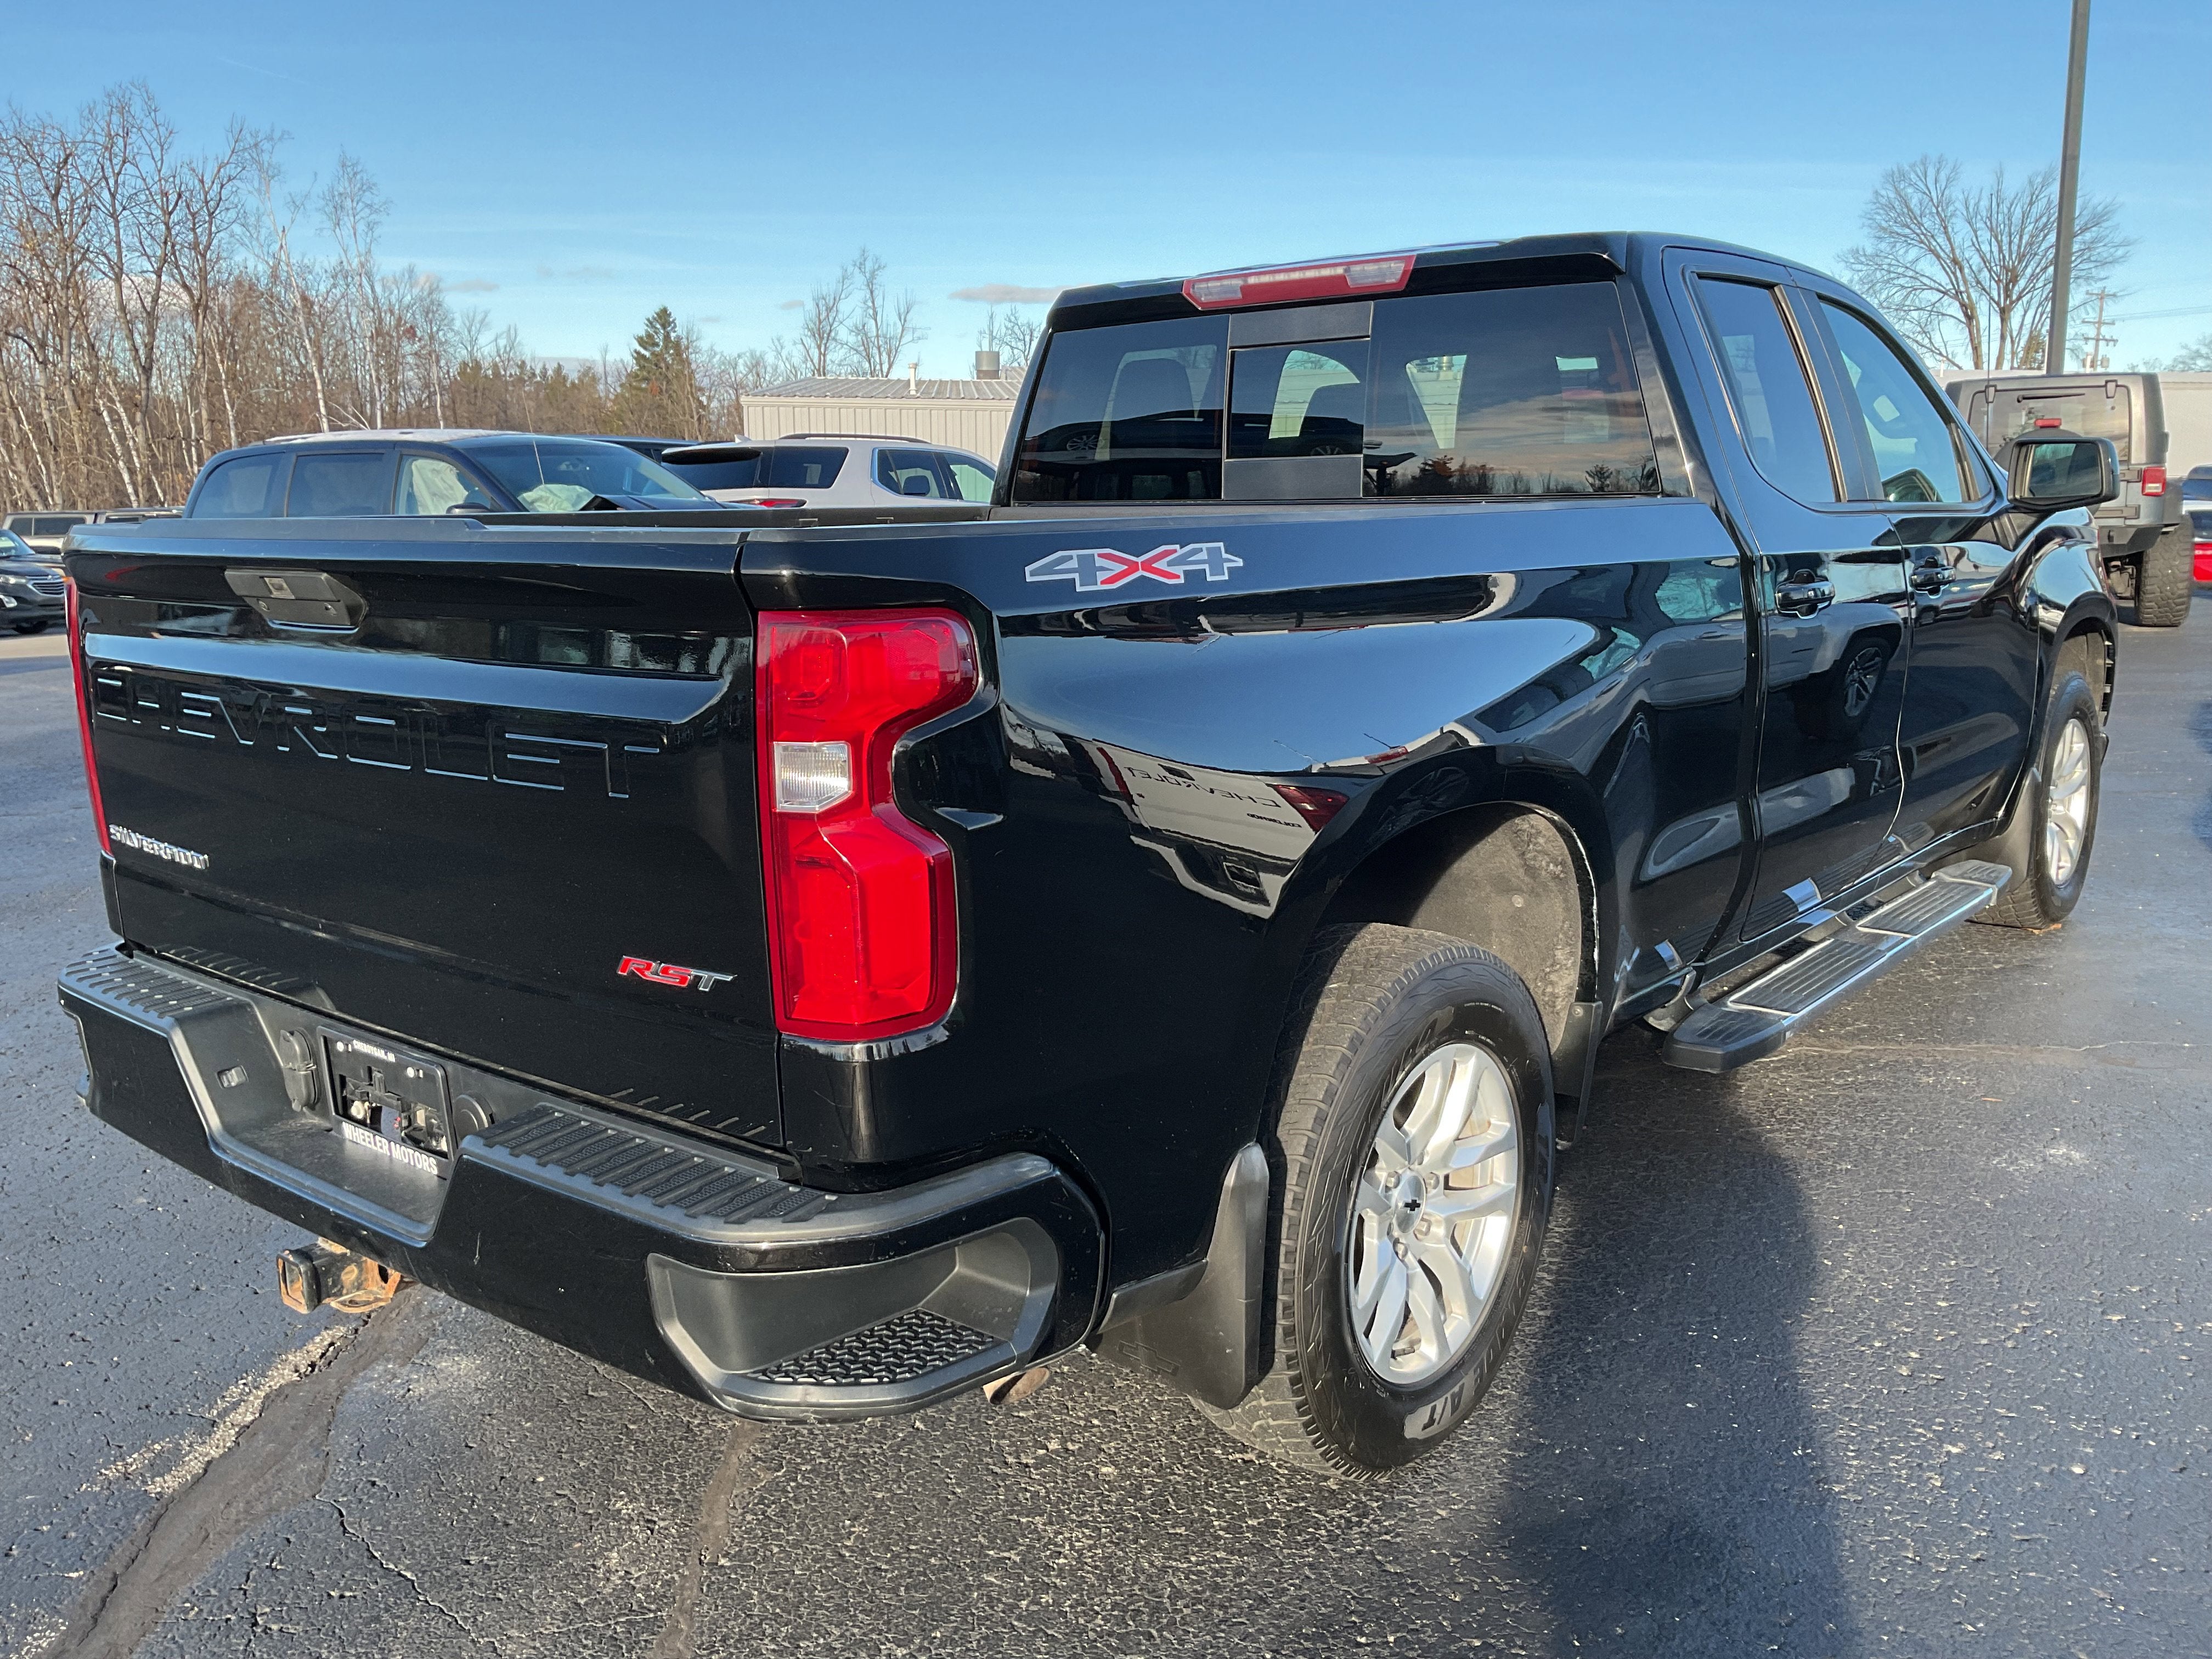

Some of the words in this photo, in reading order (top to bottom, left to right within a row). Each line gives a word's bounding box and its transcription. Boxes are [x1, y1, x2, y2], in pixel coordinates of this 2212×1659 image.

[93, 670, 661, 799] CHEVROLET
[109, 824, 210, 870] SILVERADO
[616, 955, 737, 991] RST
[342, 1121, 391, 1156] WHEELER
[390, 1141, 438, 1176] MOTORS
[1421, 1382, 1465, 1432] A/T
